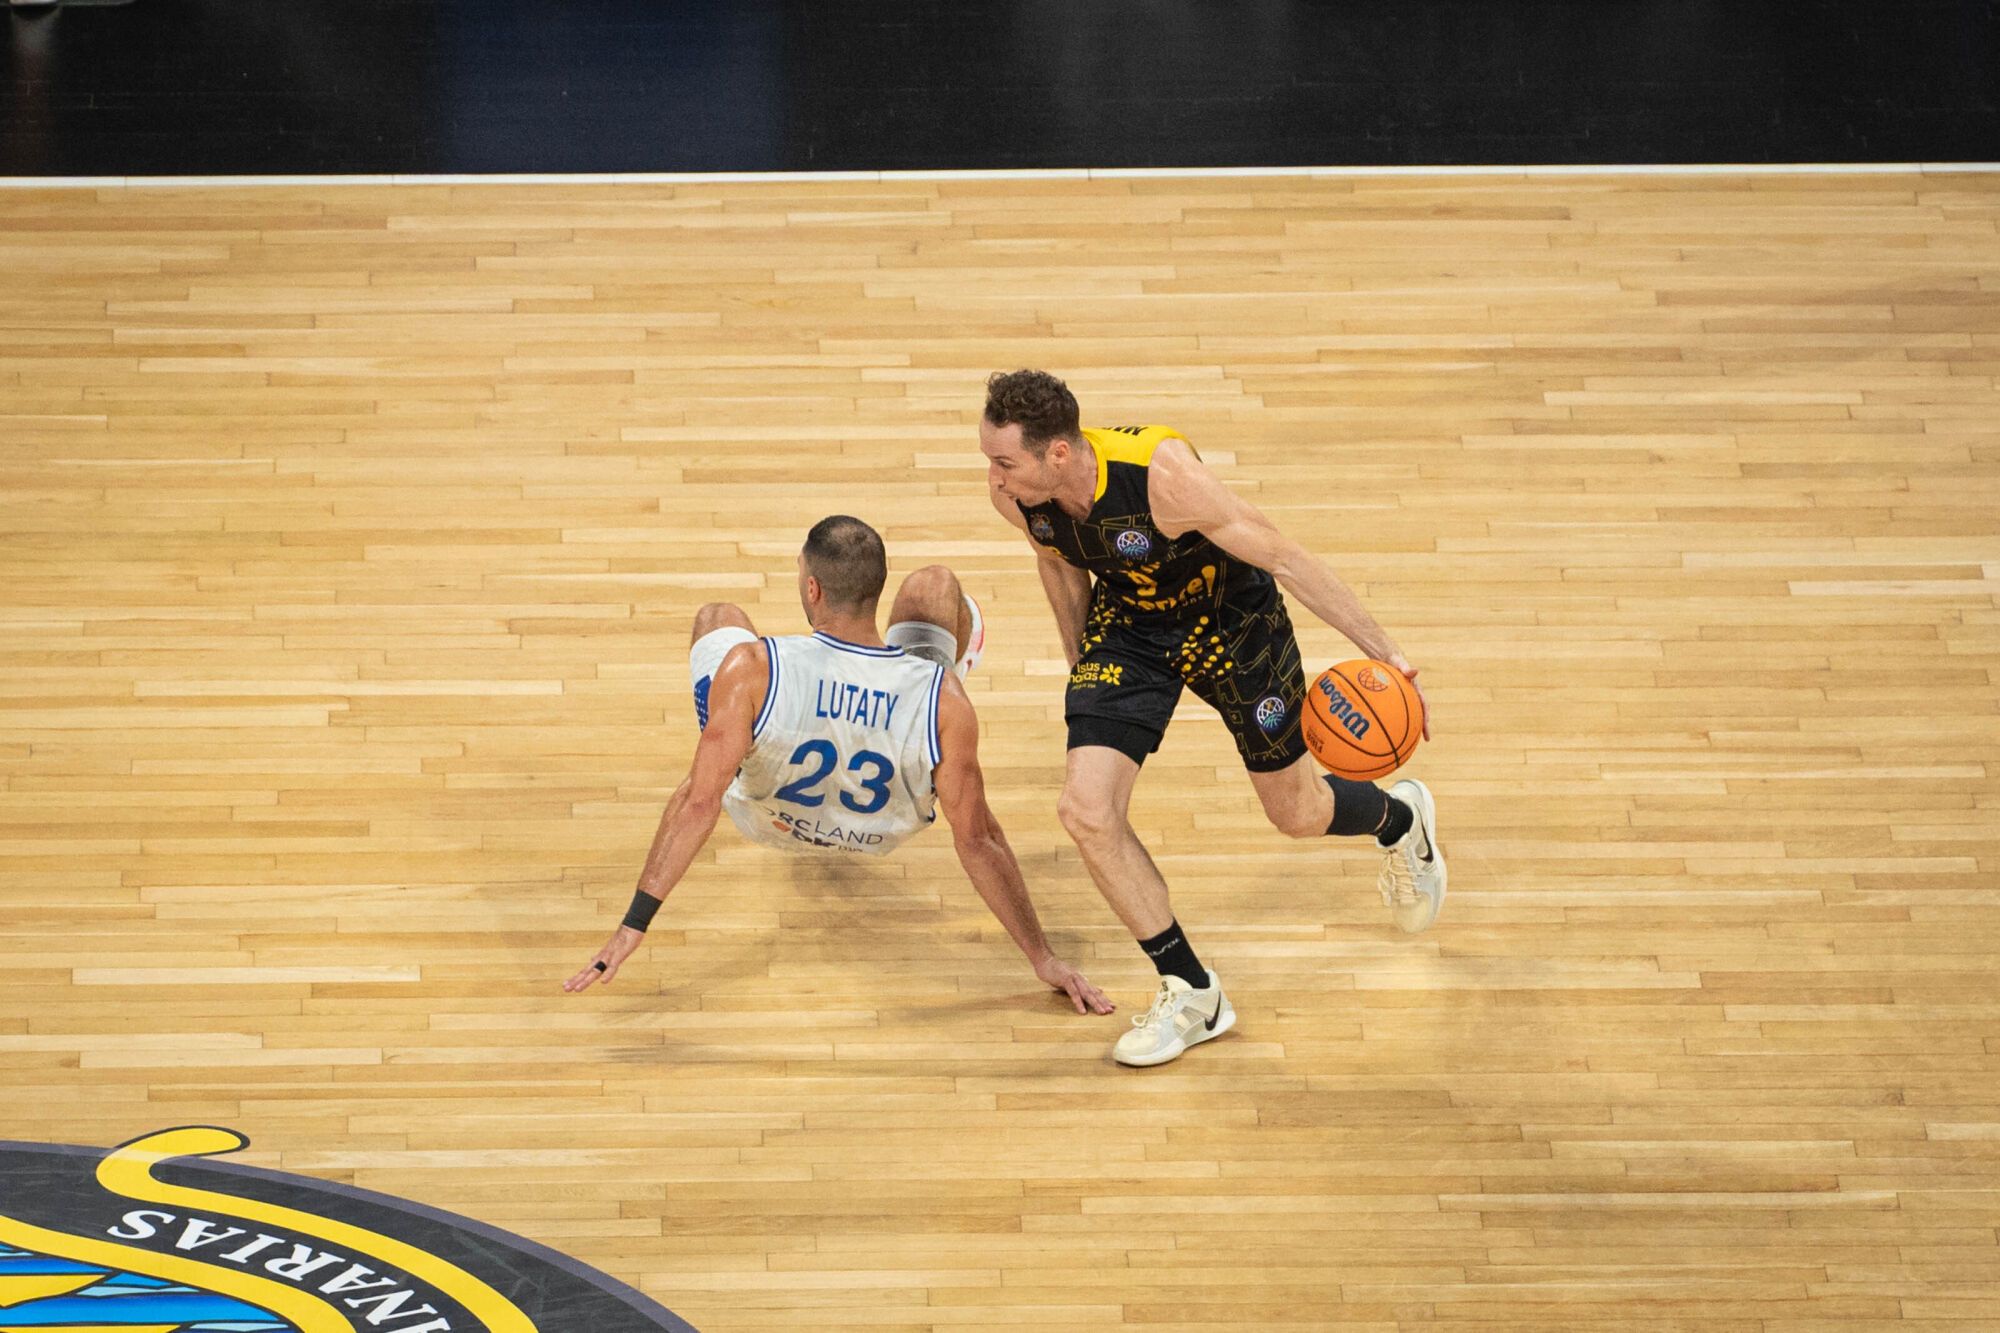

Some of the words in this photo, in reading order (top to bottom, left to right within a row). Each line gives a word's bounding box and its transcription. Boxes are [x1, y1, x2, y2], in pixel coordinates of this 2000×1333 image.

[816, 679, 899, 731] LUTATY
[1318, 675, 1370, 741] Wilson
[774, 739, 895, 814] 23
